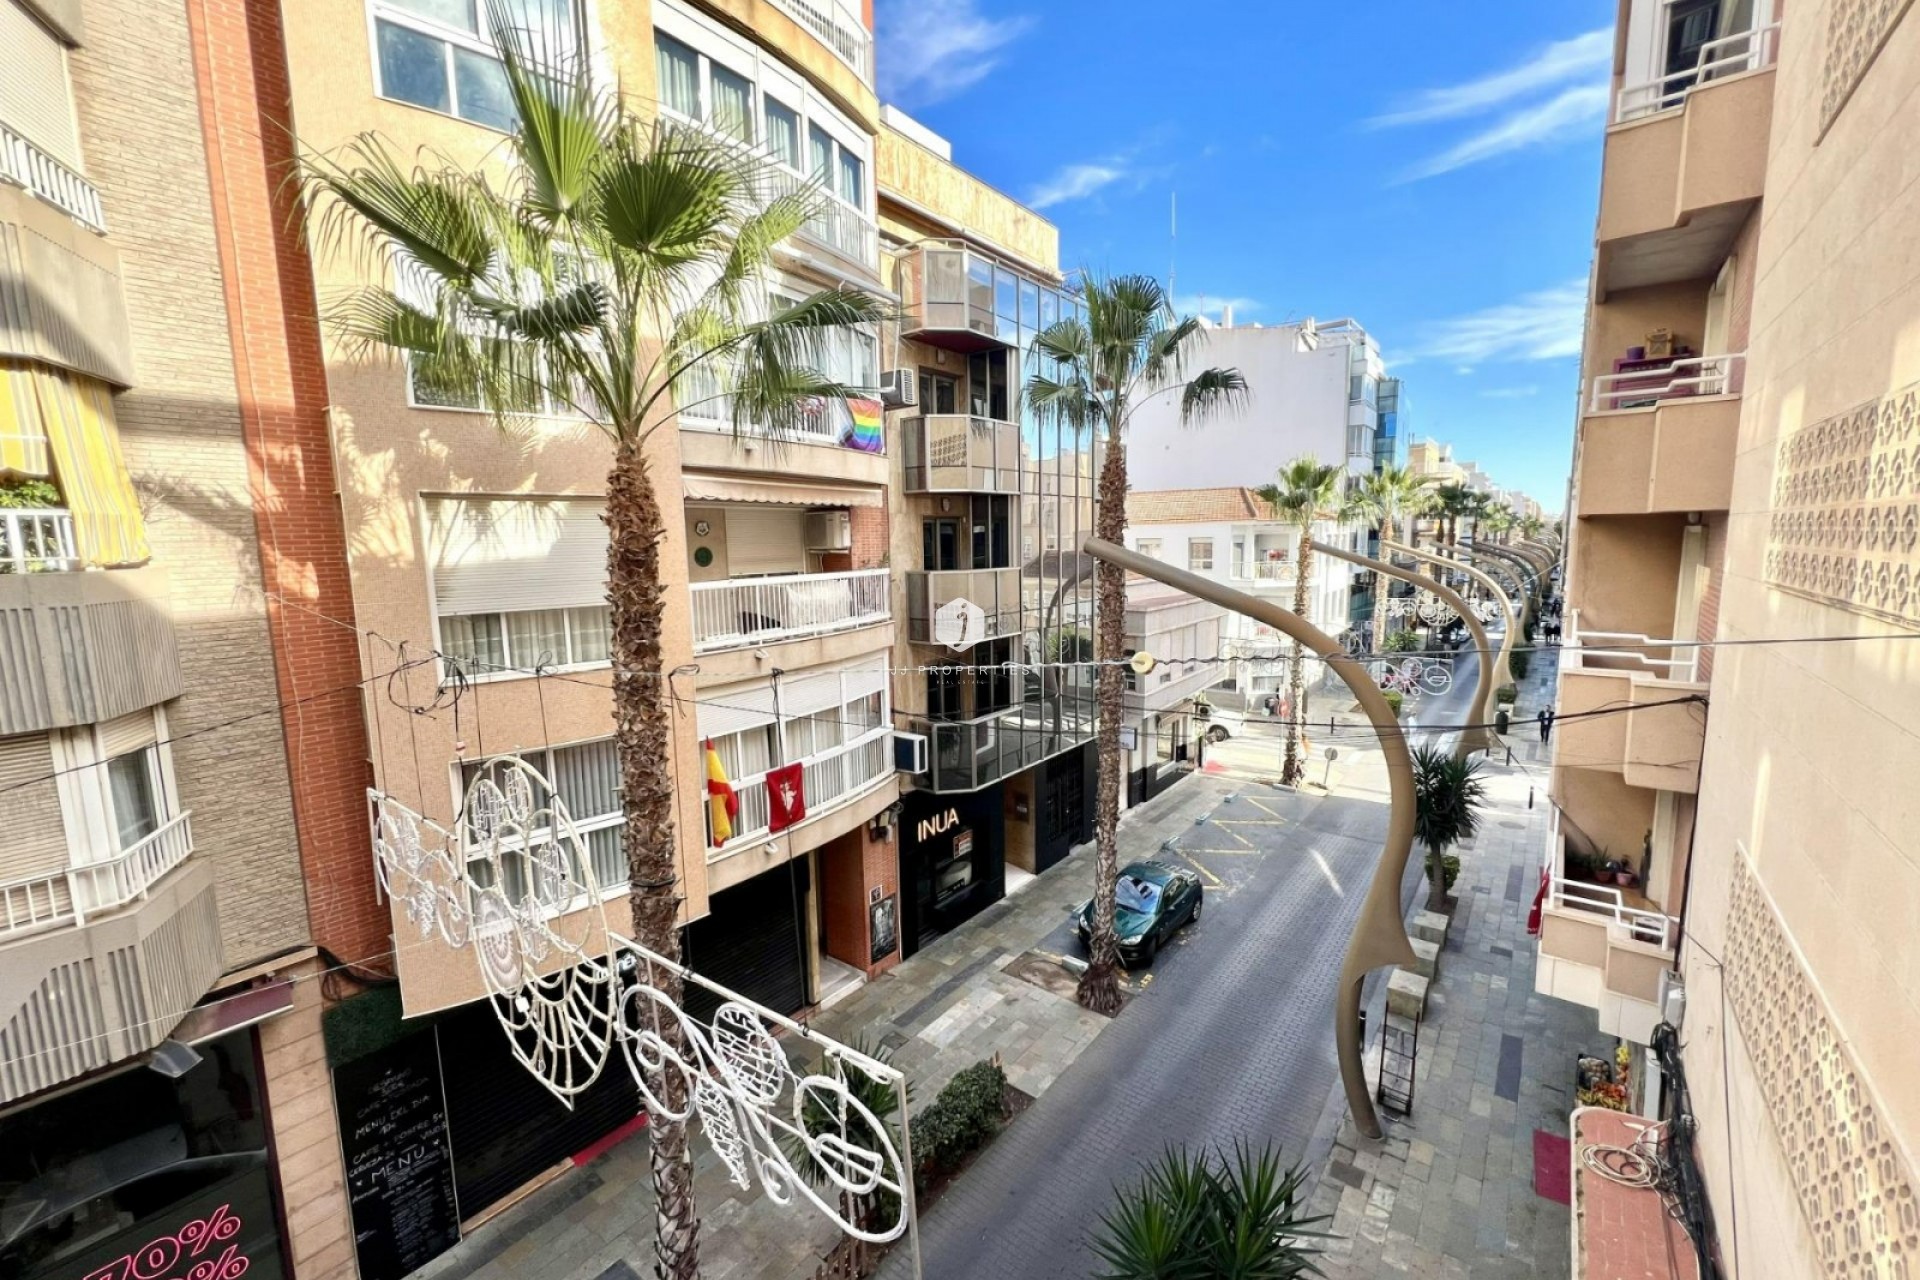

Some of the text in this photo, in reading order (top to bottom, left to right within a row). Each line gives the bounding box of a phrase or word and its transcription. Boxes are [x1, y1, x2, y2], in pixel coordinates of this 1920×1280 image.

[918, 808, 960, 843] INUA
[355, 1115, 387, 1140] MENU
[371, 1145, 425, 1184] MENU
